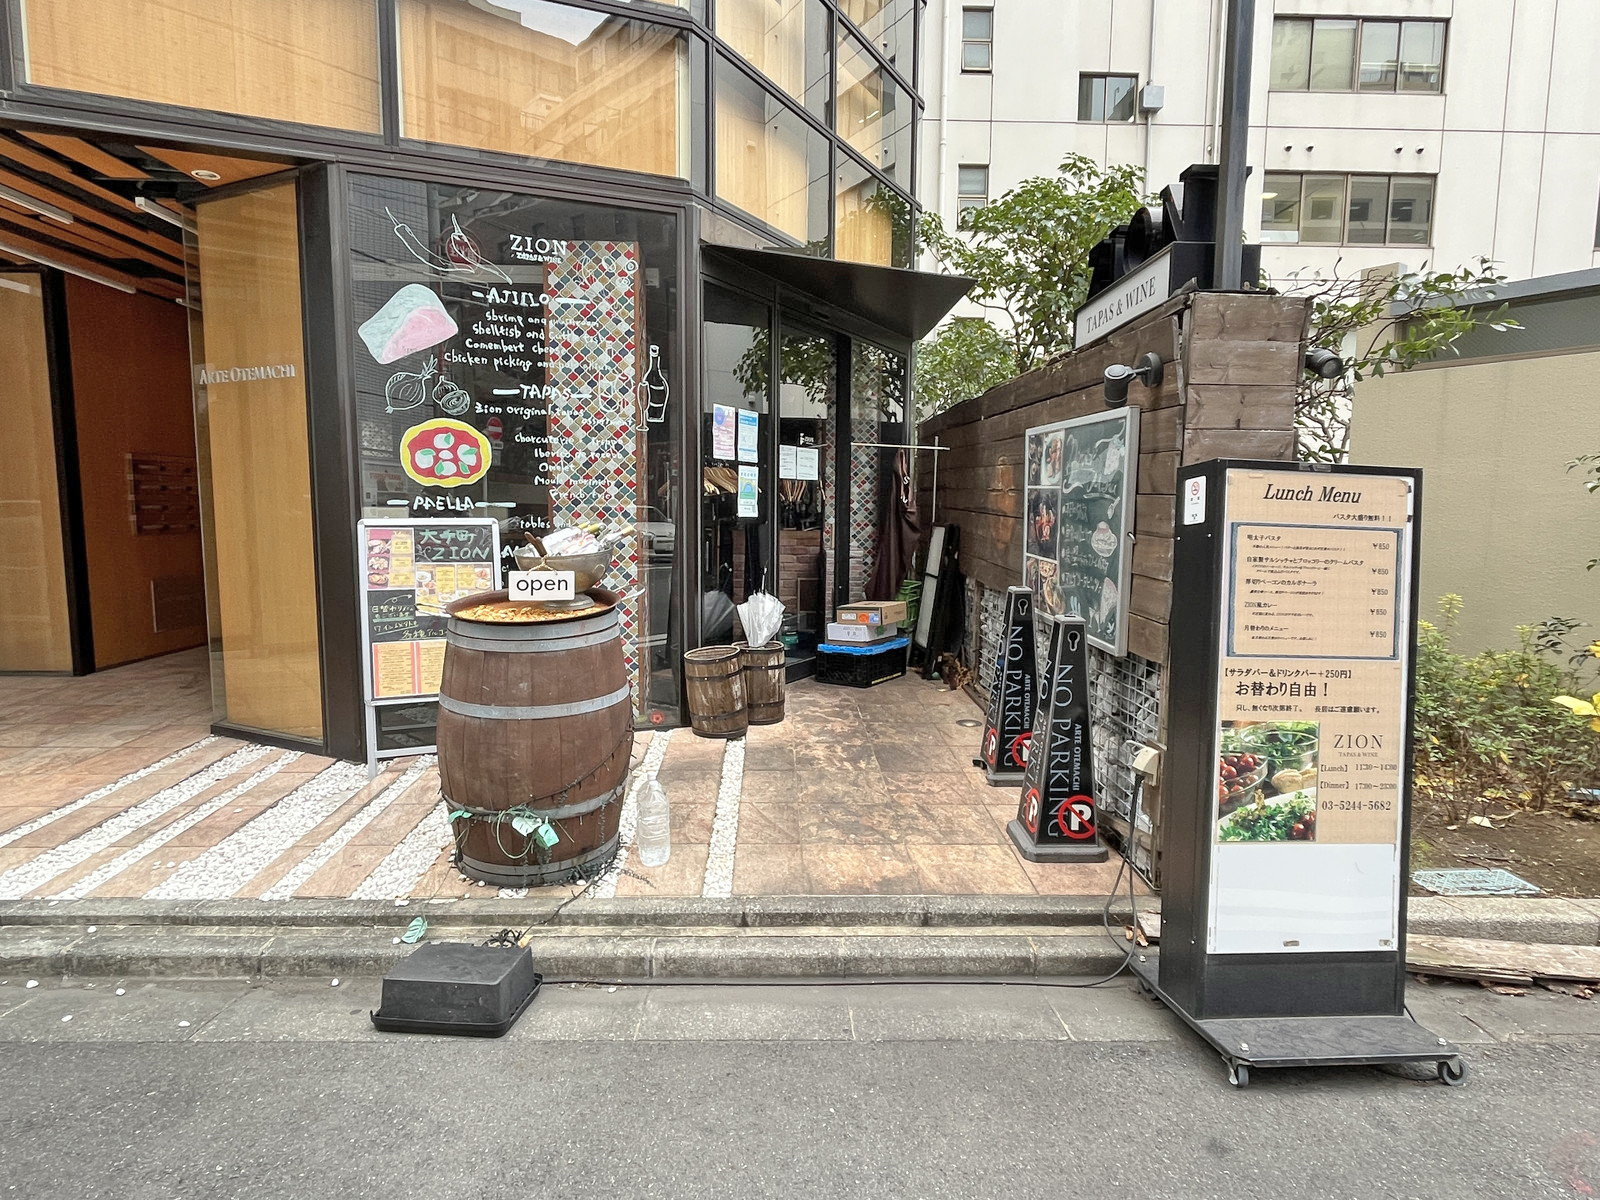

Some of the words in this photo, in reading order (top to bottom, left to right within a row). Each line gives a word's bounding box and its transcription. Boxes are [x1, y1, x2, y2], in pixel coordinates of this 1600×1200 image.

[509, 234, 568, 256] ZION
[1086, 303, 1115, 334] TAPAS
[1116, 299, 1123, 317] &
[1125, 276, 1156, 311] WINE
[526, 331, 545, 341] and
[493, 354, 533, 372] picking
[520, 384, 572, 400] TAPAS
[1263, 483, 1314, 502] Lunch
[1318, 486, 1362, 504] Menu
[413, 495, 475, 511] PAELLA
[420, 528, 478, 545] 大手町
[431, 546, 491, 560] ZION
[1372, 542, 1390, 550] ¥850
[1371, 568, 1389, 576] ¥850
[516, 579, 568, 597] open
[1371, 587, 1389, 596] ¥850
[1370, 607, 1388, 617] ¥850
[1369, 630, 1387, 639] ¥850
[1007, 626, 1024, 661] NO
[1054, 664, 1074, 708] NO
[1235, 681, 1329, 697] お替わり自由！
[1074, 723, 1082, 745] ARTE
[1333, 734, 1384, 749] ZION
[1047, 718, 1072, 838] PARKING
[1321, 800, 1391, 811] 03-5244-5682
